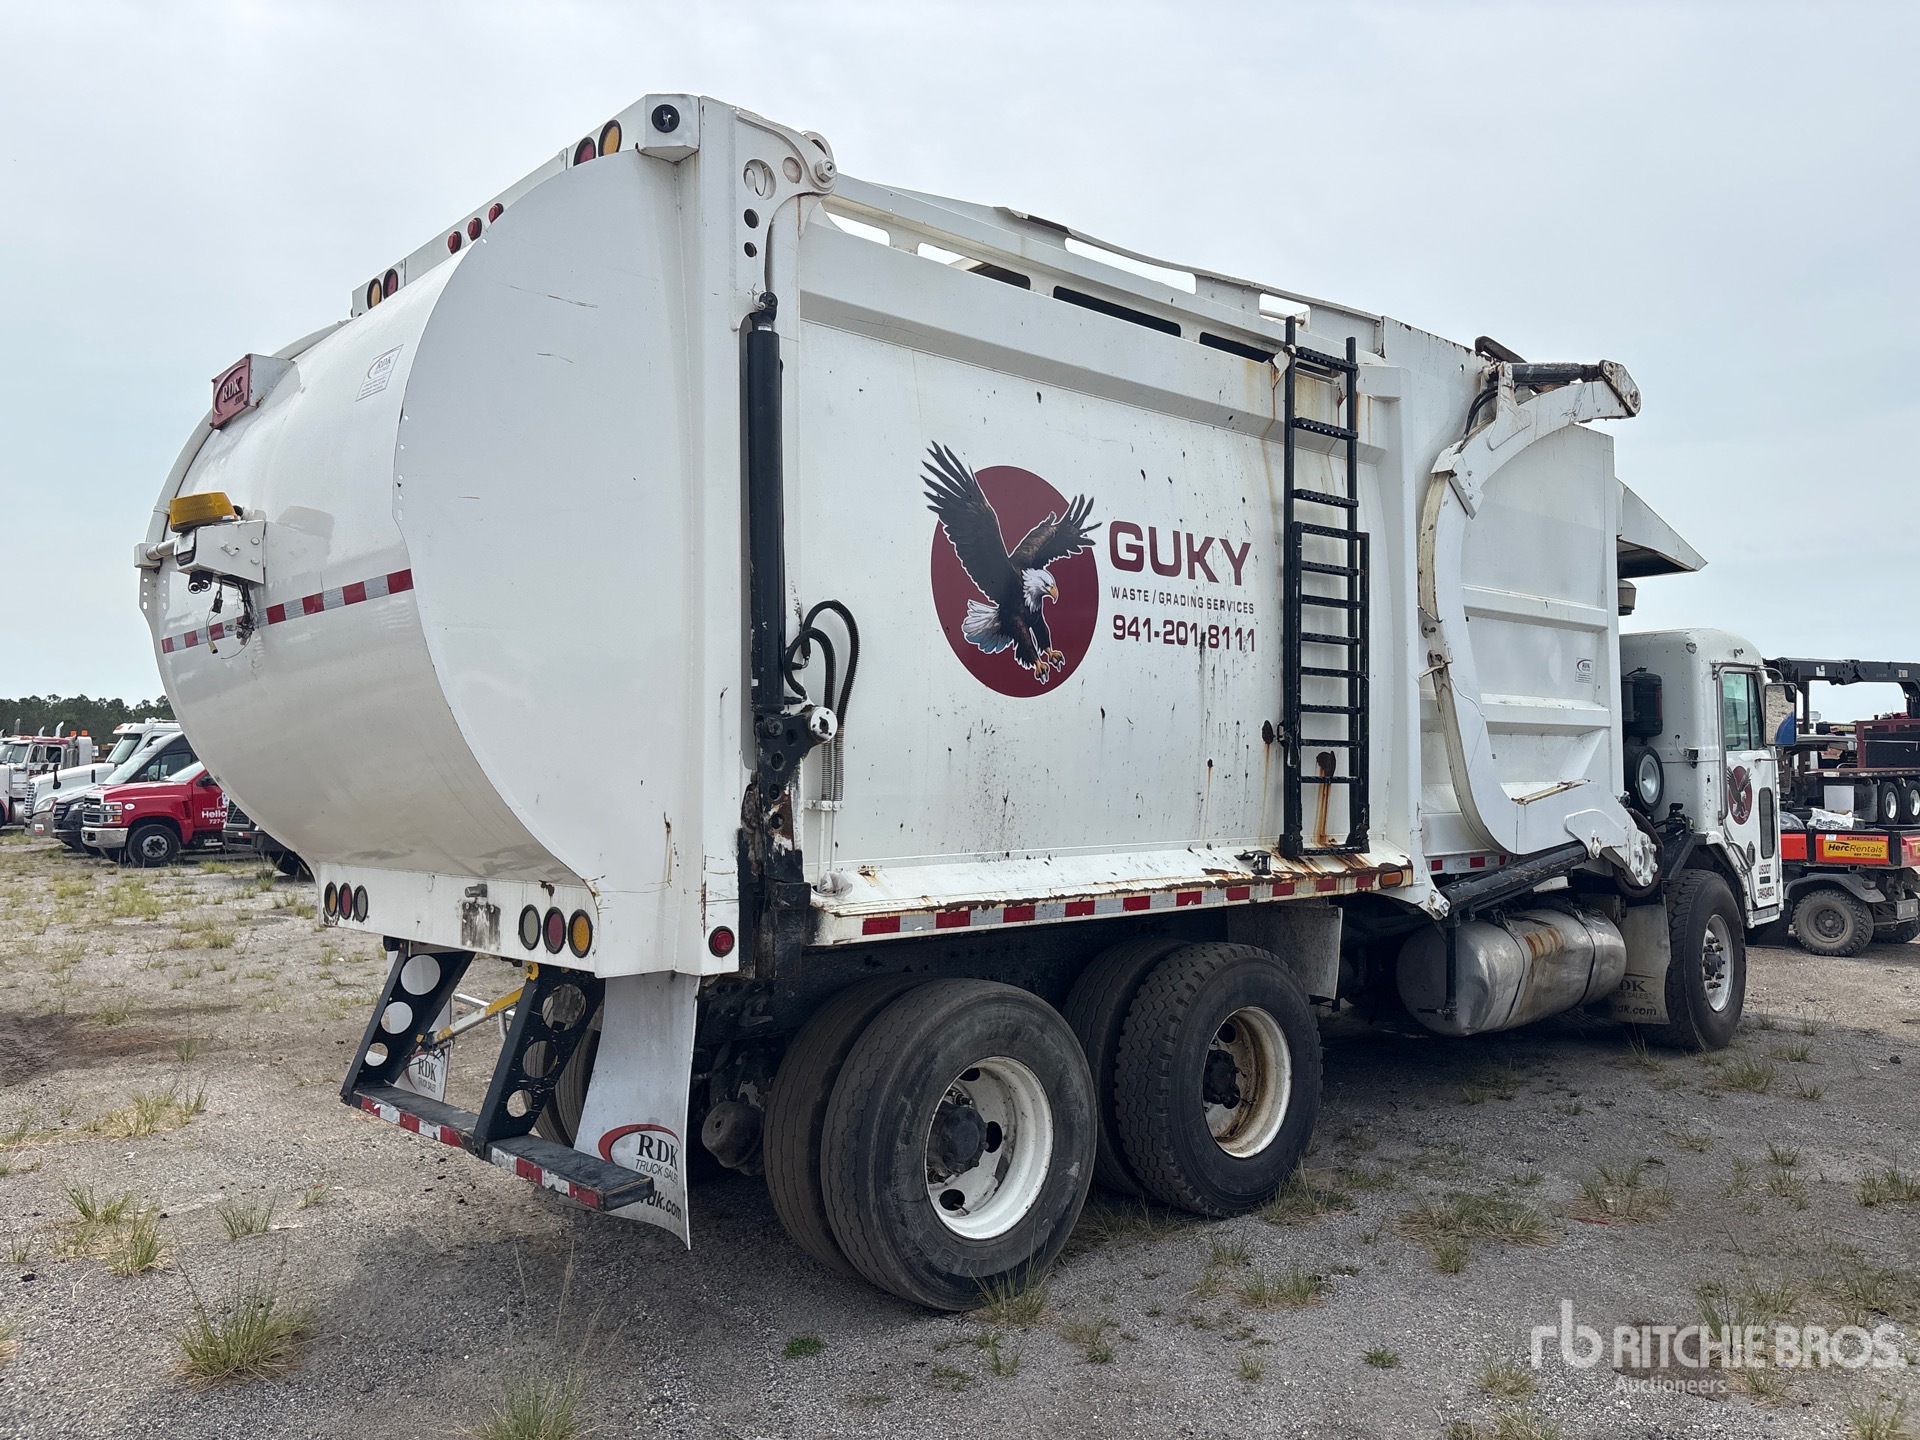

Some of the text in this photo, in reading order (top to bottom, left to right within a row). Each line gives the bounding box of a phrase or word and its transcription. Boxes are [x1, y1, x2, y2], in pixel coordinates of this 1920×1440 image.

[222, 376, 244, 402] RDK
[1109, 520, 1251, 586] GUKY
[1206, 600, 1254, 615] SERVICES
[1113, 614, 1255, 652] 941-2018111
[201, 810, 227, 818] Hello
[1619, 979, 1647, 992] DK
[418, 1058, 438, 1082] RDK
[636, 1133, 679, 1172] RDK
[635, 1159, 663, 1176] TRUCK
